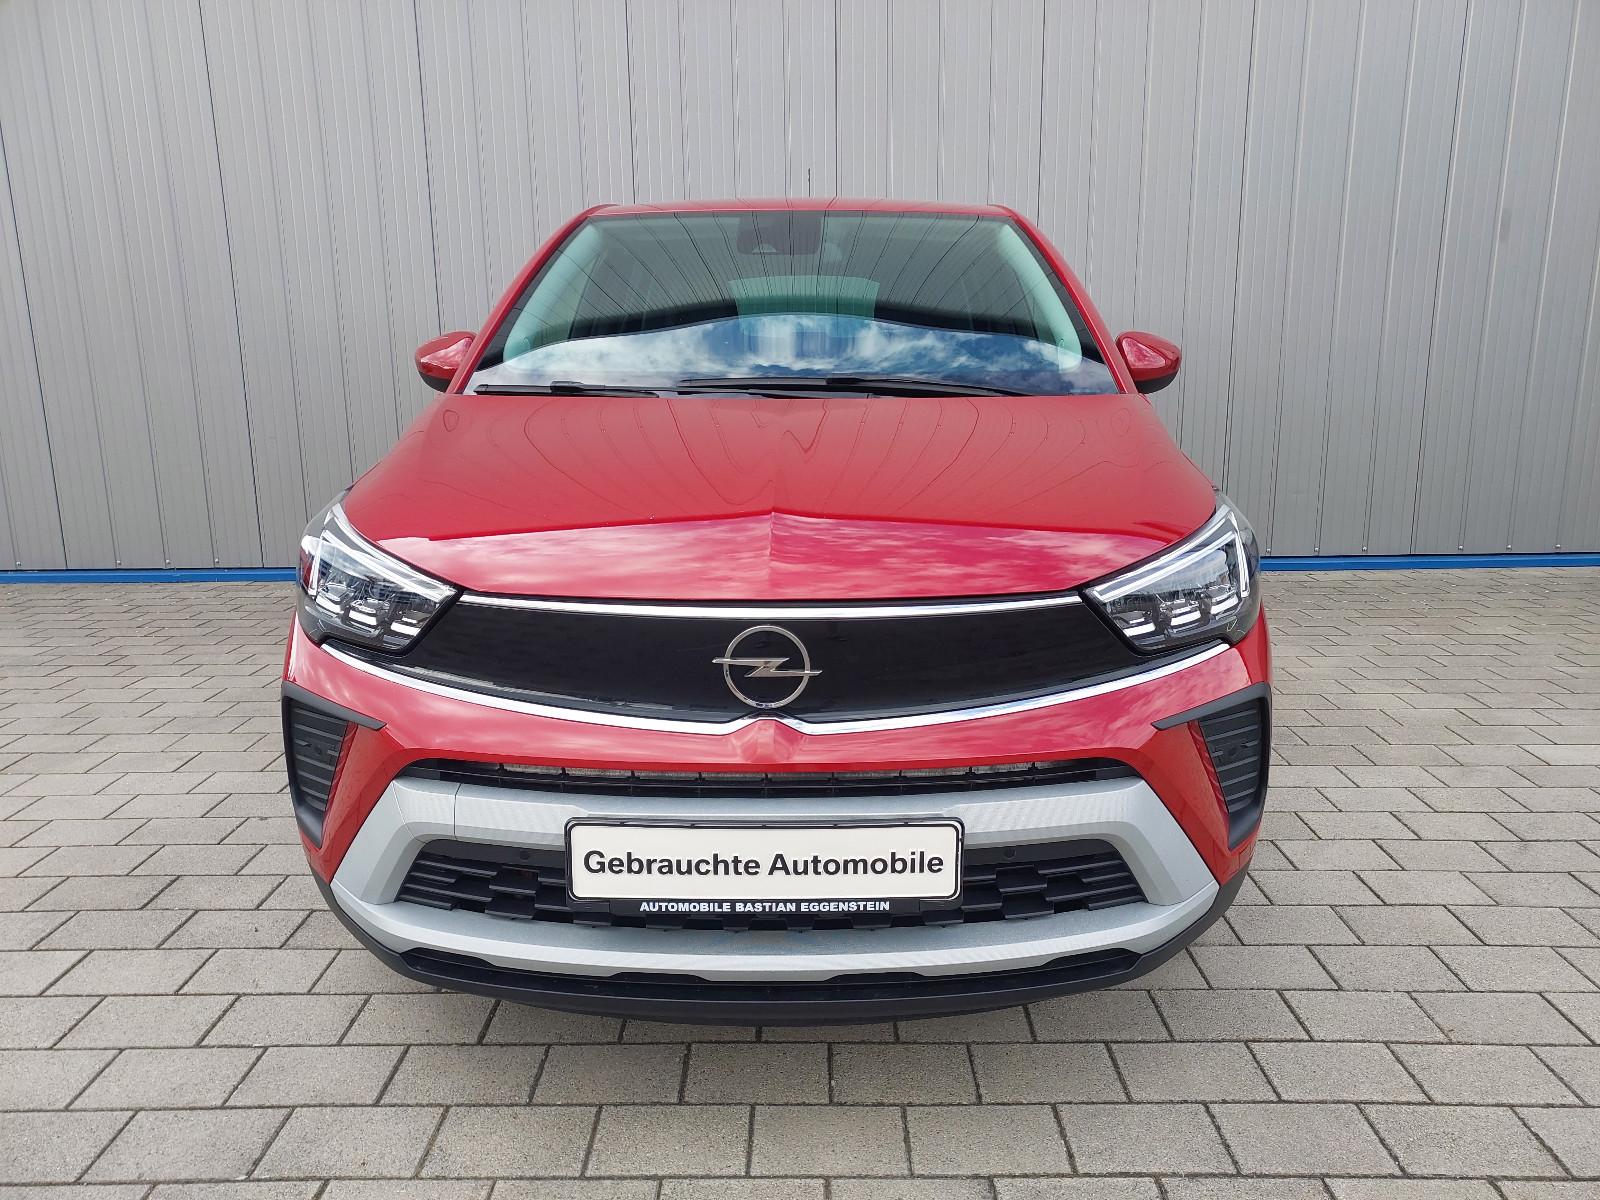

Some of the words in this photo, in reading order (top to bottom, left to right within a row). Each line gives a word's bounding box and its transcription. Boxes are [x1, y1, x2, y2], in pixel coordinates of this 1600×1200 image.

[583, 850, 761, 876] Gebrauchte
[768, 851, 944, 876] Automobile
[639, 901, 732, 913] AUTOMOBILE
[735, 902, 797, 912] BASTIAN
[799, 901, 891, 912] EGGENSTEIN
